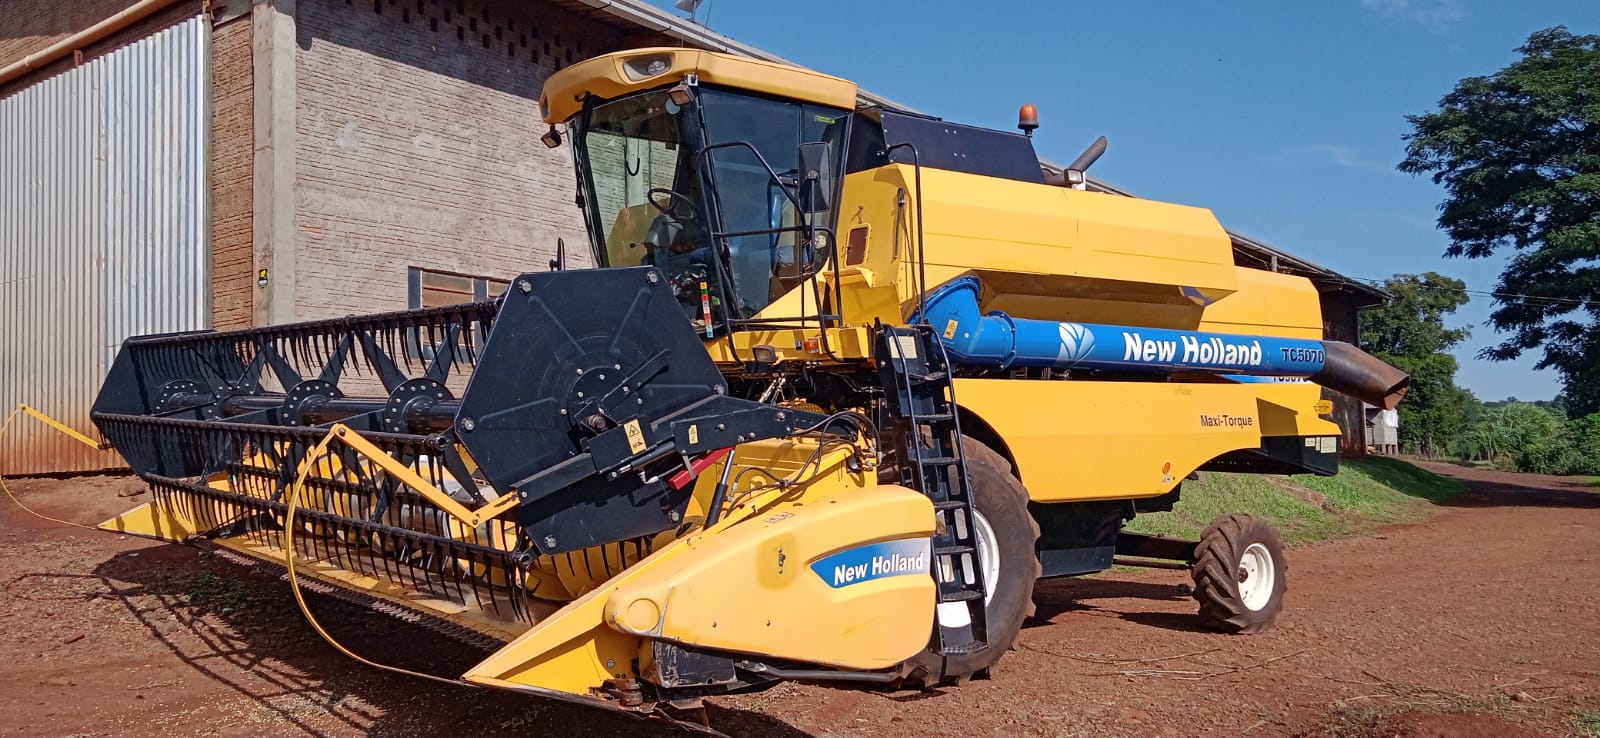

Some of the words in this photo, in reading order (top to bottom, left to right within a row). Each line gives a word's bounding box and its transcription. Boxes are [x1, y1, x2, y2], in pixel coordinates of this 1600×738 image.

[1122, 331, 1176, 361] New
[1181, 336, 1262, 366] Holland
[1281, 347, 1325, 363] TC5070
[1200, 415, 1253, 427] Maxi-Torque
[834, 563, 868, 585] New
[872, 553, 923, 575] Holland
